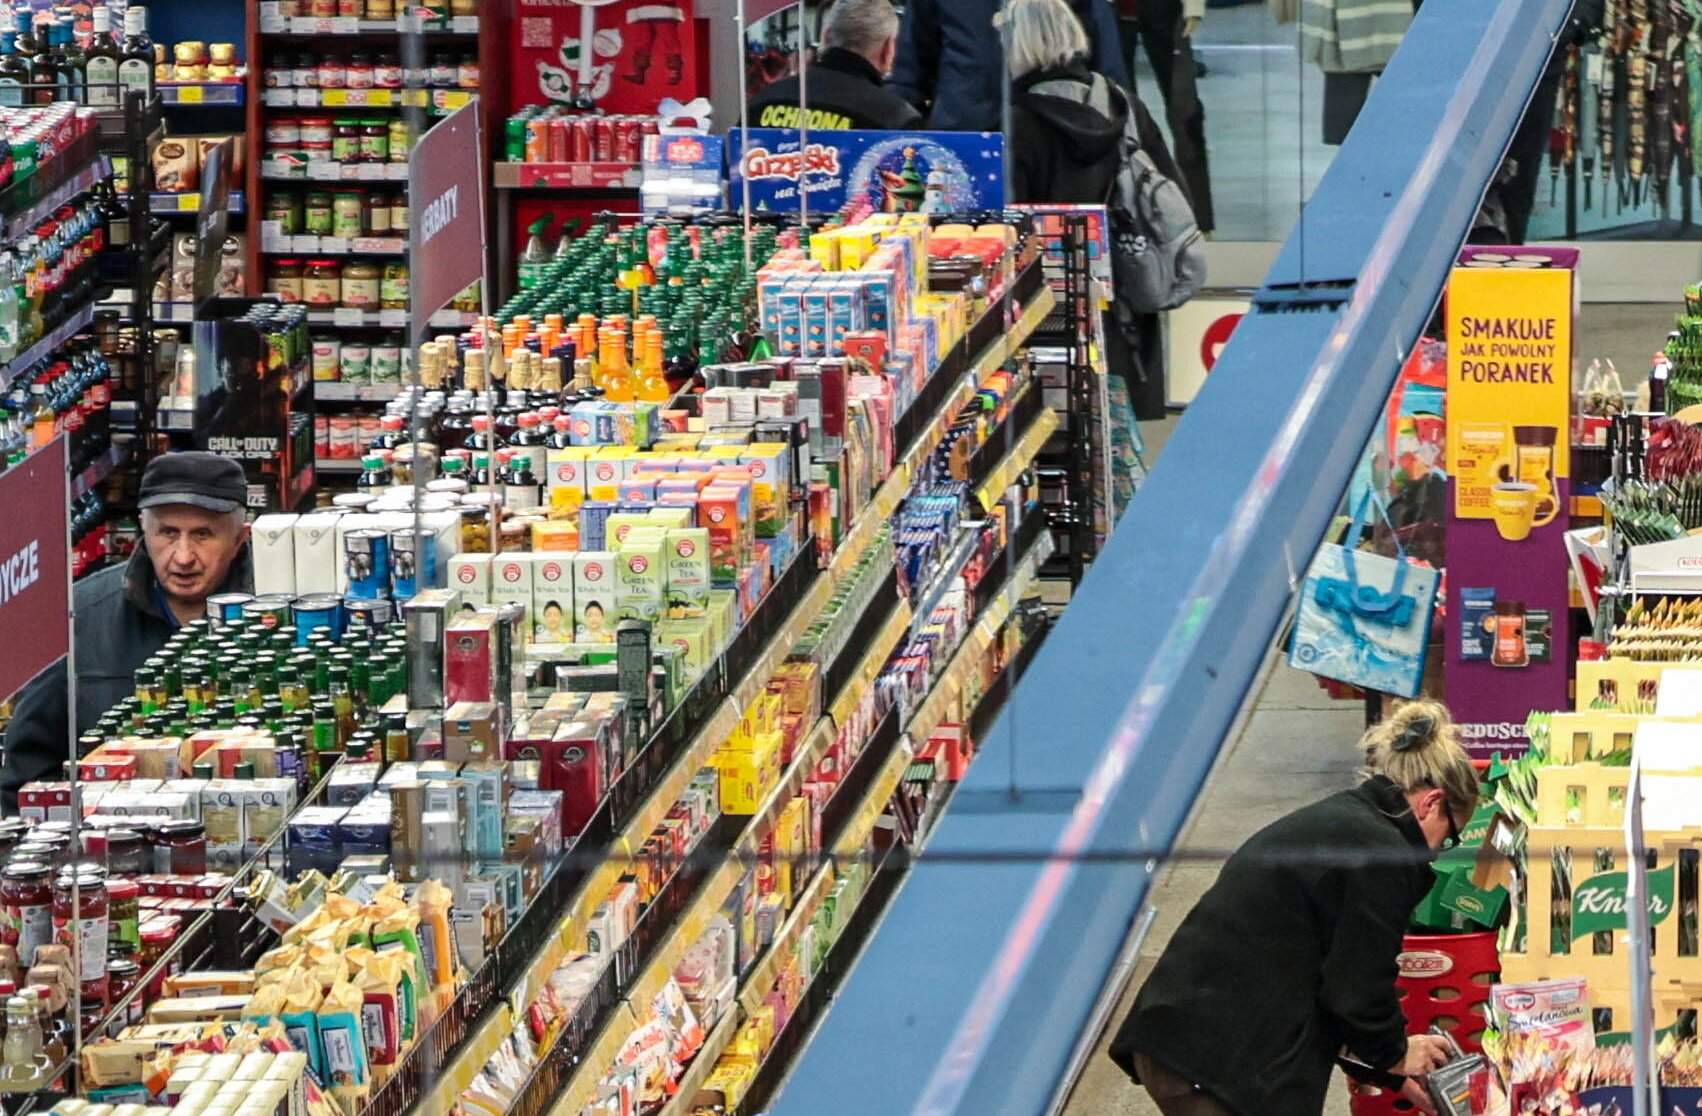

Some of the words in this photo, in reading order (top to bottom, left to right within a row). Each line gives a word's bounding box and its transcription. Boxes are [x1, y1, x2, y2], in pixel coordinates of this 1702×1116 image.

[760, 104, 853, 130] OCHRONA
[1461, 317, 1556, 340] SMAKUJE
[1461, 343, 1485, 357] JAK
[1491, 343, 1556, 358] POWOLNY
[1461, 360, 1554, 384] PORANEK
[244, 437, 278, 450] DUTY
[0, 539, 39, 607] YCZE
